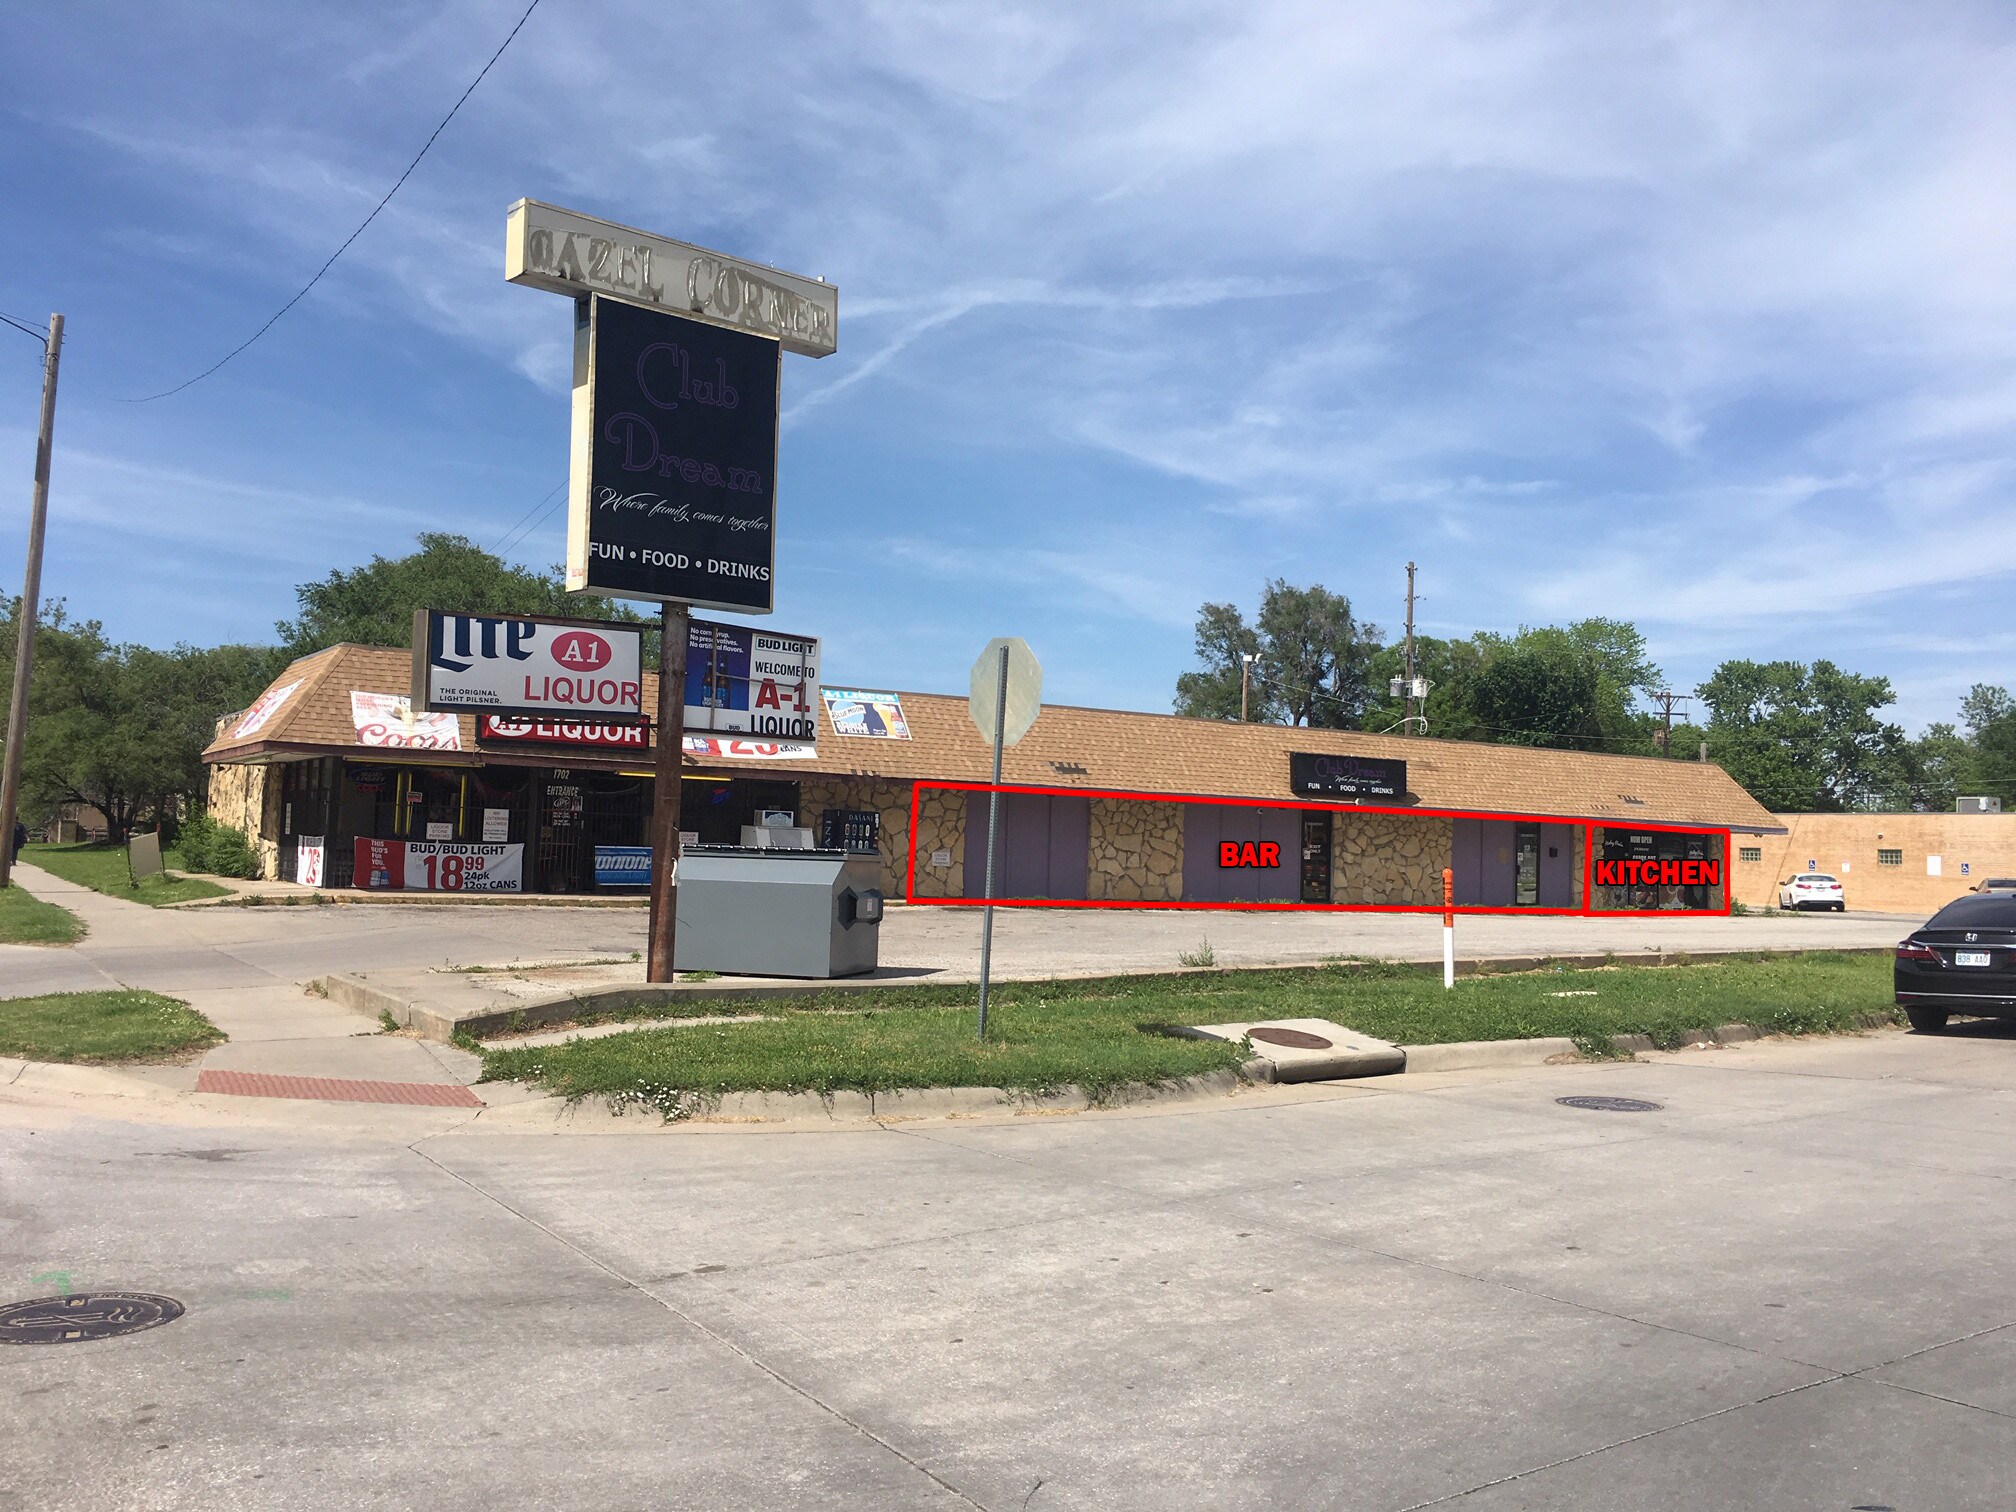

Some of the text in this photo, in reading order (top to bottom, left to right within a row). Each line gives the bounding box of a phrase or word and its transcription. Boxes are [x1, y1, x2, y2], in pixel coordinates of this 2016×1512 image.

[686, 256, 833, 344] CORNER
[636, 342, 740, 409] Club
[604, 412, 764, 496] Dream
[648, 499, 690, 523] family
[693, 510, 725, 523] comes
[727, 516, 769, 532] together
[588, 541, 770, 582] FUN FOOD DRINKS
[690, 627, 700, 635] No
[690, 634, 699, 642] No
[561, 639, 600, 664] A1
[689, 641, 699, 649] No
[723, 645, 744, 654] flavors.
[757, 638, 782, 650] BUD
[755, 660, 815, 680] WELCOME TO
[459, 688, 498, 697] ORIGINAL
[524, 675, 640, 706] LIQUOR
[755, 678, 811, 713] A-1
[439, 695, 502, 704] LIGHT PILSNER.
[832, 705, 864, 720] BLUE MOON
[536, 716, 643, 743] LIQUOR
[750, 714, 815, 738] LIQUOR
[356, 723, 460, 750] Coors
[553, 769, 570, 780] 1702
[1315, 757, 1387, 778] Club Dream
[547, 785, 579, 797] ENTRANCE
[848, 814, 874, 822] DASANI
[371, 839, 384, 847] THIS
[410, 843, 507, 855] BUD/BUD LIGHT
[423, 855, 485, 890] 18 99
[464, 870, 490, 880] 24pk
[464, 880, 517, 890] 12oz CANS
